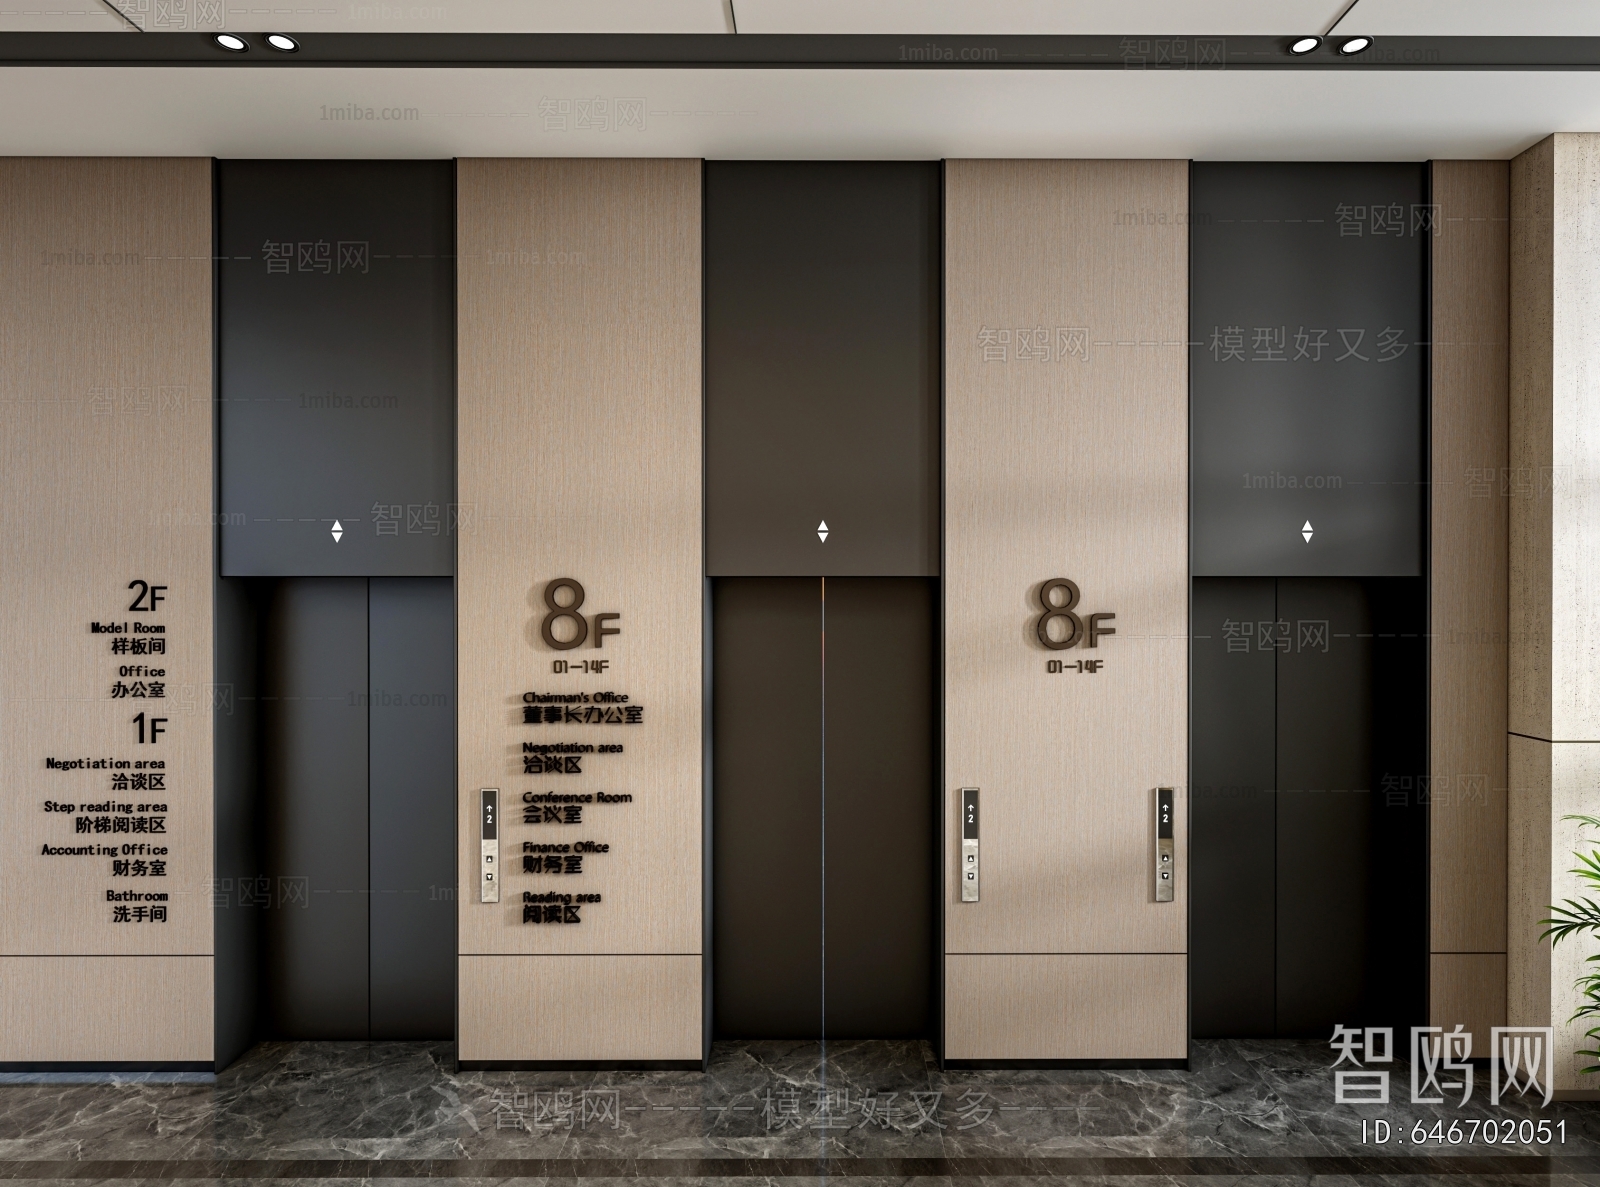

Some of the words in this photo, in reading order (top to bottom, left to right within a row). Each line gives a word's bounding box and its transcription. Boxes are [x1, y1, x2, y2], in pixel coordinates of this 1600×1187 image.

[128, 580, 168, 612] 2F
[541, 578, 621, 650] 8F
[1037, 577, 1116, 650] 8F
[91, 622, 129, 634] Model
[133, 622, 166, 634] Room
[112, 637, 166, 655] 样板间
[119, 665, 166, 677] Office
[111, 680, 166, 699] 办公室
[522, 692, 590, 703] Chairman's
[593, 691, 629, 703] Office
[522, 705, 643, 724] 董事长办公室
[133, 711, 168, 744] 1F
[522, 742, 594, 756] Negotiation
[597, 744, 623, 753] area
[46, 757, 131, 771] Negotiation
[134, 759, 166, 769] area
[523, 755, 582, 774] 洽谈区
[111, 773, 166, 790] 洽谈区
[522, 791, 593, 804] Conference
[596, 792, 633, 804] Room
[44, 800, 76, 814] Step
[79, 800, 134, 814] reading
[137, 802, 168, 812] area
[522, 805, 583, 824] 会议室
[75, 816, 167, 833] 阶梯阅读区
[486, 815, 493, 824] 2
[968, 814, 974, 823] 2
[1162, 814, 1169, 823] 2
[41, 844, 118, 857] Accounting
[121, 844, 168, 856] Office
[522, 841, 571, 854] Finance
[573, 841, 610, 854] Office
[112, 859, 167, 877] 财务室
[522, 855, 583, 874] 财务室
[106, 890, 169, 901] Bathroom
[522, 891, 573, 905] Reading
[575, 893, 602, 903] area
[113, 905, 167, 923] 洗手间
[522, 904, 581, 924] 阅读区
